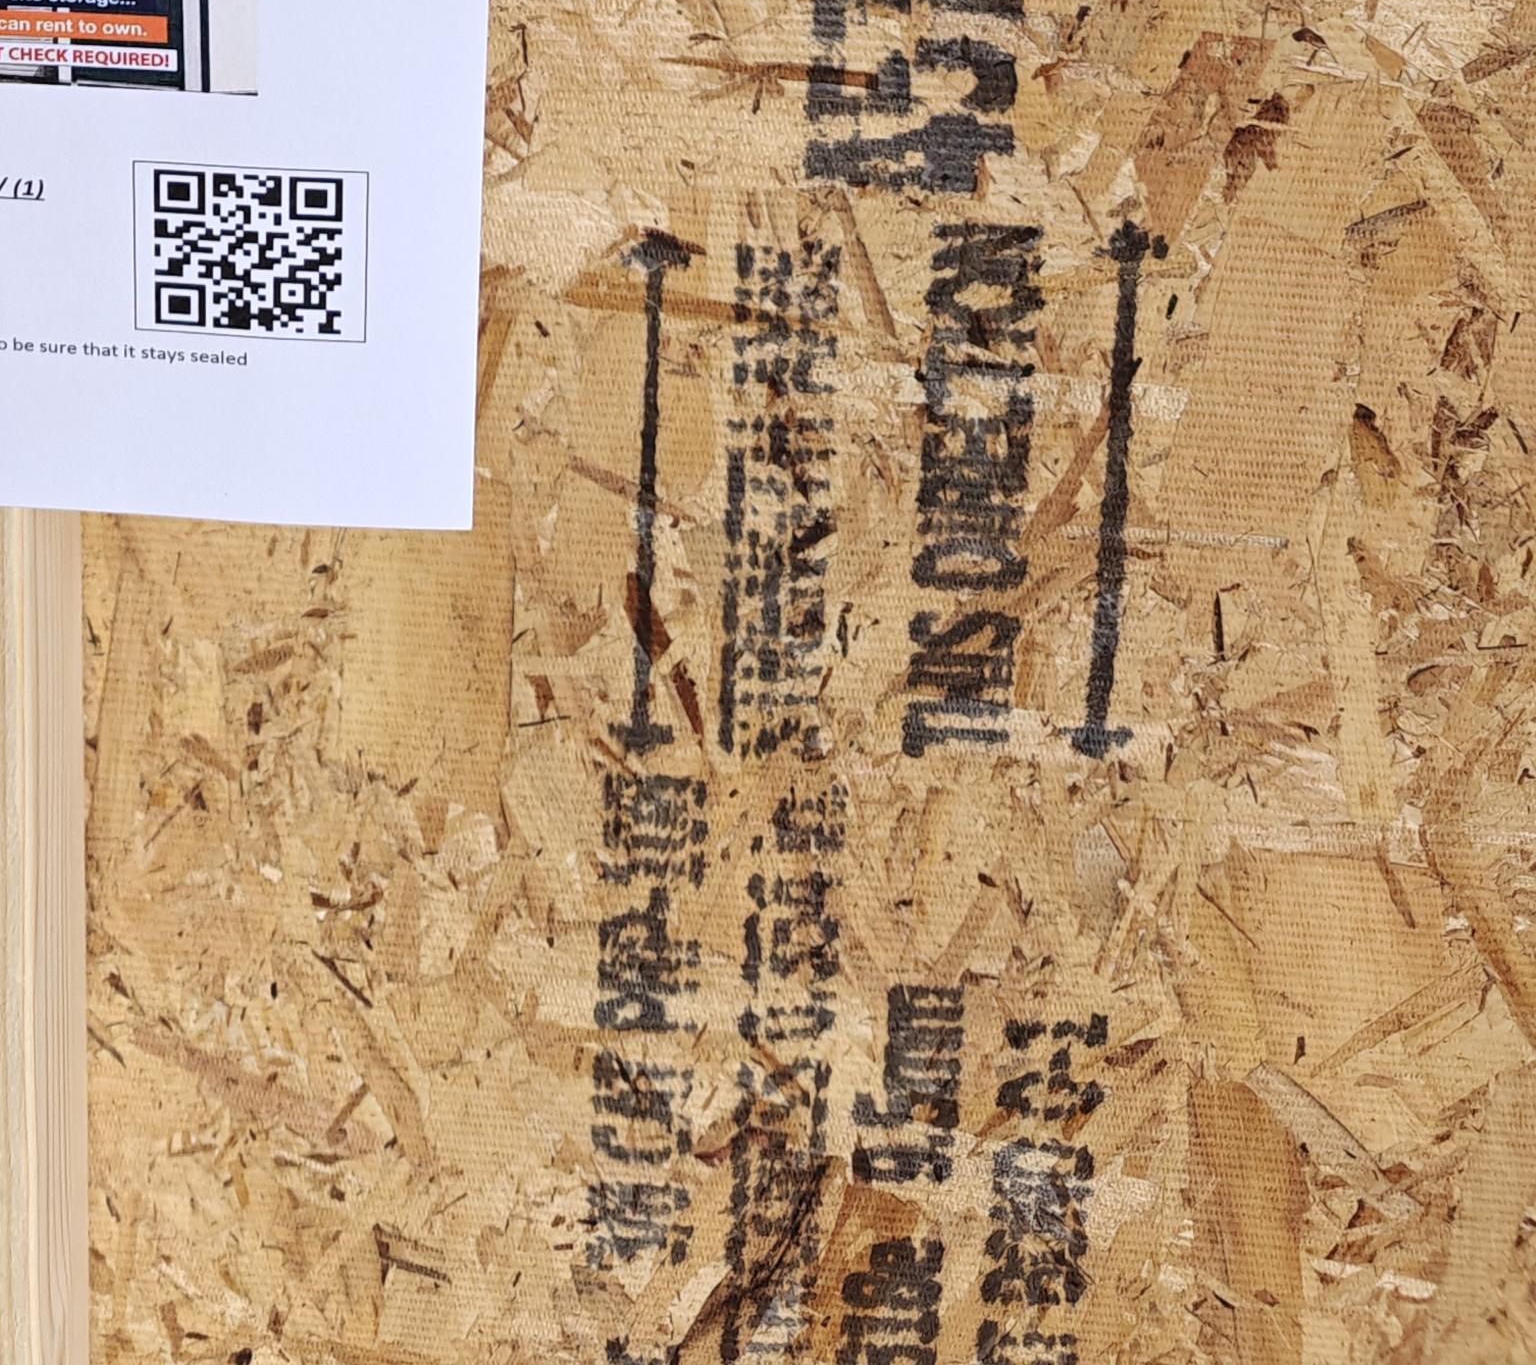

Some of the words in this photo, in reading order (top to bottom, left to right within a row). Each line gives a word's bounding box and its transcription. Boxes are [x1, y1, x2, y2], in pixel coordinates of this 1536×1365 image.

[36, 17, 74, 34] rent
[77, 19, 98, 35] to
[102, 22, 148, 37] own.
[8, 46, 68, 63] CHECK
[72, 48, 170, 68] REQUIRED!
[10, 178, 45, 201] (1)
[13, 338, 34, 351] be
[40, 343, 77, 354] sure
[83, 342, 118, 357] that
[124, 345, 135, 358] it
[141, 348, 184, 363] stays
[191, 351, 247, 365] sealed
[909, 222, 1046, 592] DIRECTION
[901, 608, 1023, 758] THIS
